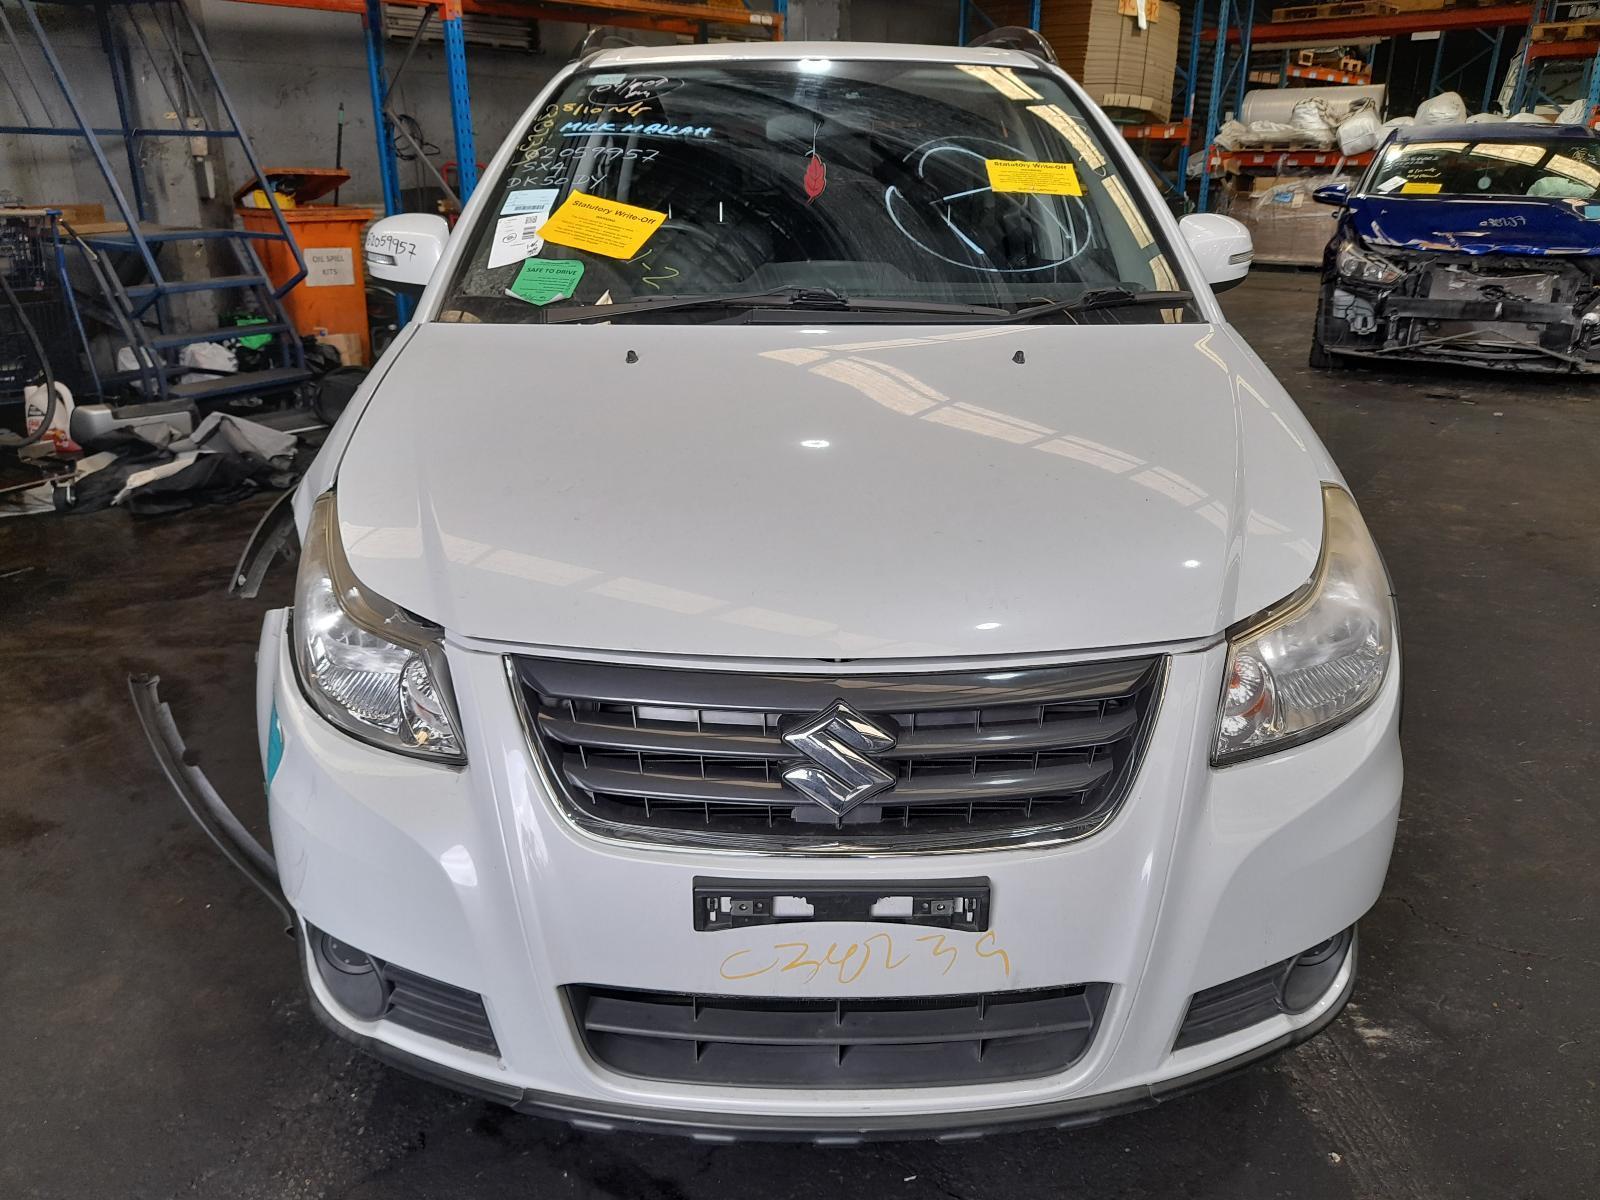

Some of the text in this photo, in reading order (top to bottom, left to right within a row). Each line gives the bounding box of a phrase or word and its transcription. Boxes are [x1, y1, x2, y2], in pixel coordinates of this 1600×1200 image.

[560, 121, 616, 132] MICK
[521, 161, 567, 177] SX4
[994, 161, 1031, 169] Statutory
[572, 200, 613, 215] Statutory
[614, 210, 657, 225] Write-Off
